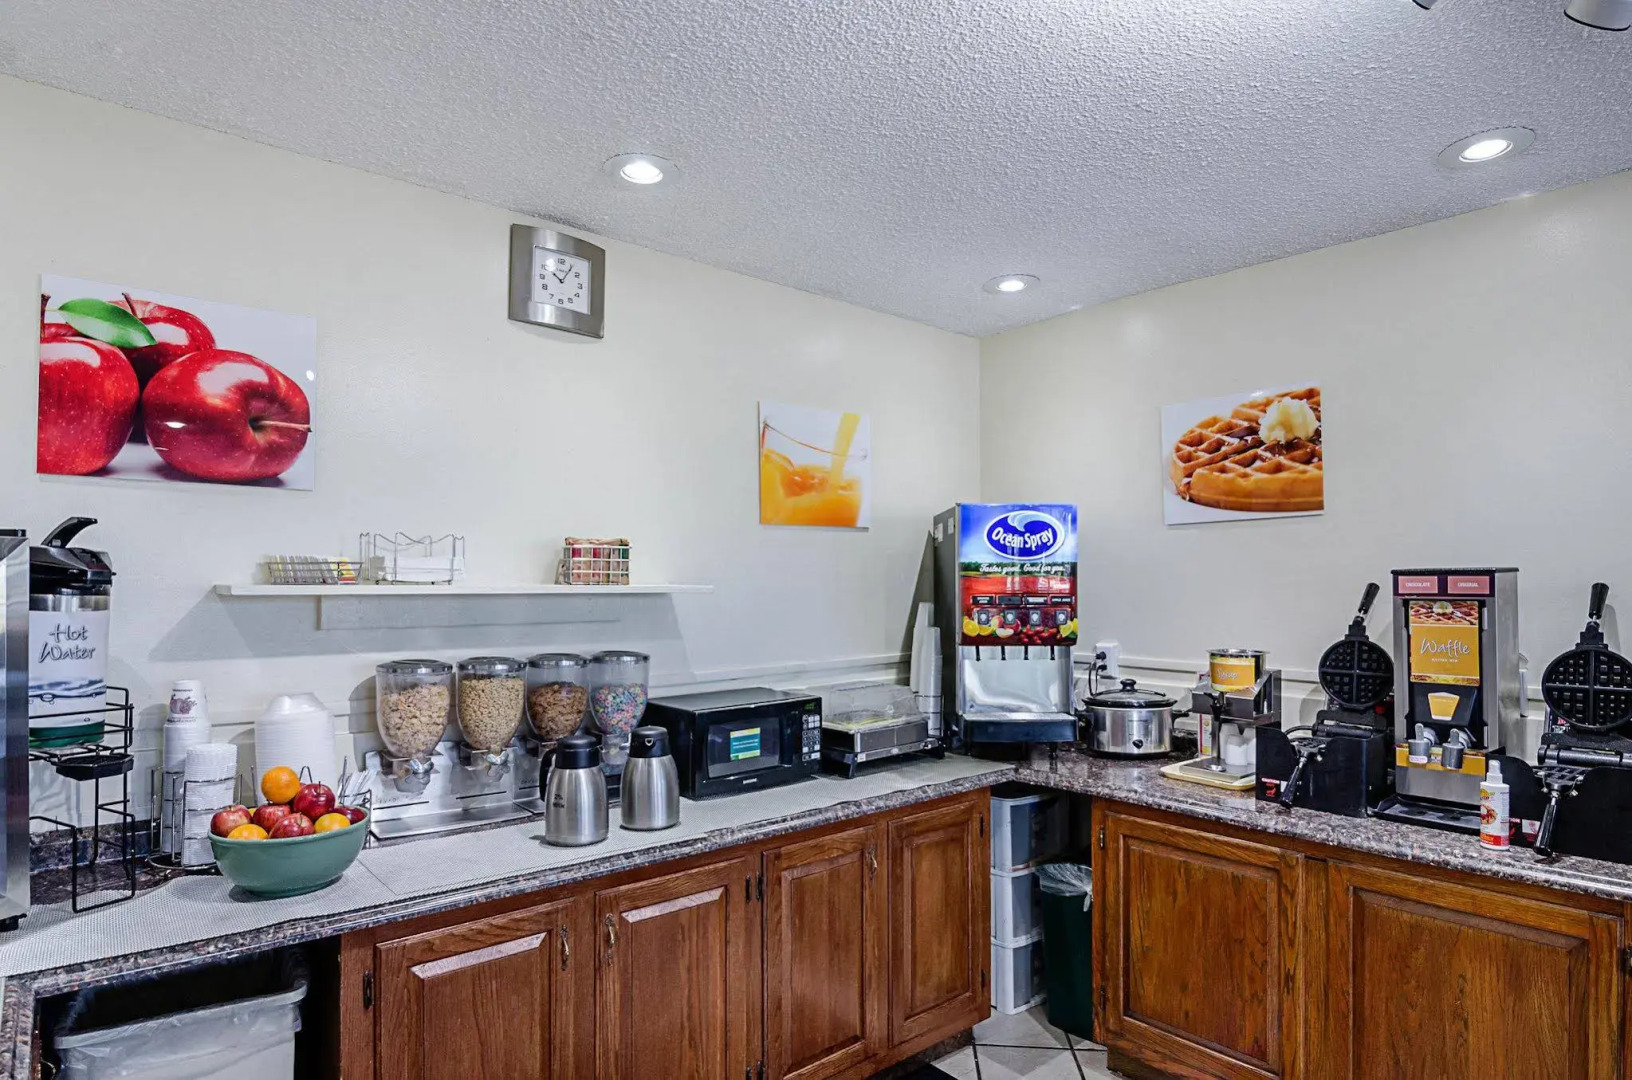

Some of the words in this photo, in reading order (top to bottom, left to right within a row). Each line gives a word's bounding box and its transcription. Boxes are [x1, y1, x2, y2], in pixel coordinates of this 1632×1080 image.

[574, 271, 580, 279] 2
[577, 282, 583, 290] 3
[991, 526, 1024, 548] Ocean
[1024, 527, 1054, 551] Spray
[1023, 563, 1042, 573] Good
[49, 623, 88, 643] Hot
[38, 642, 96, 664] Water
[1420, 637, 1470, 658] Waffle
